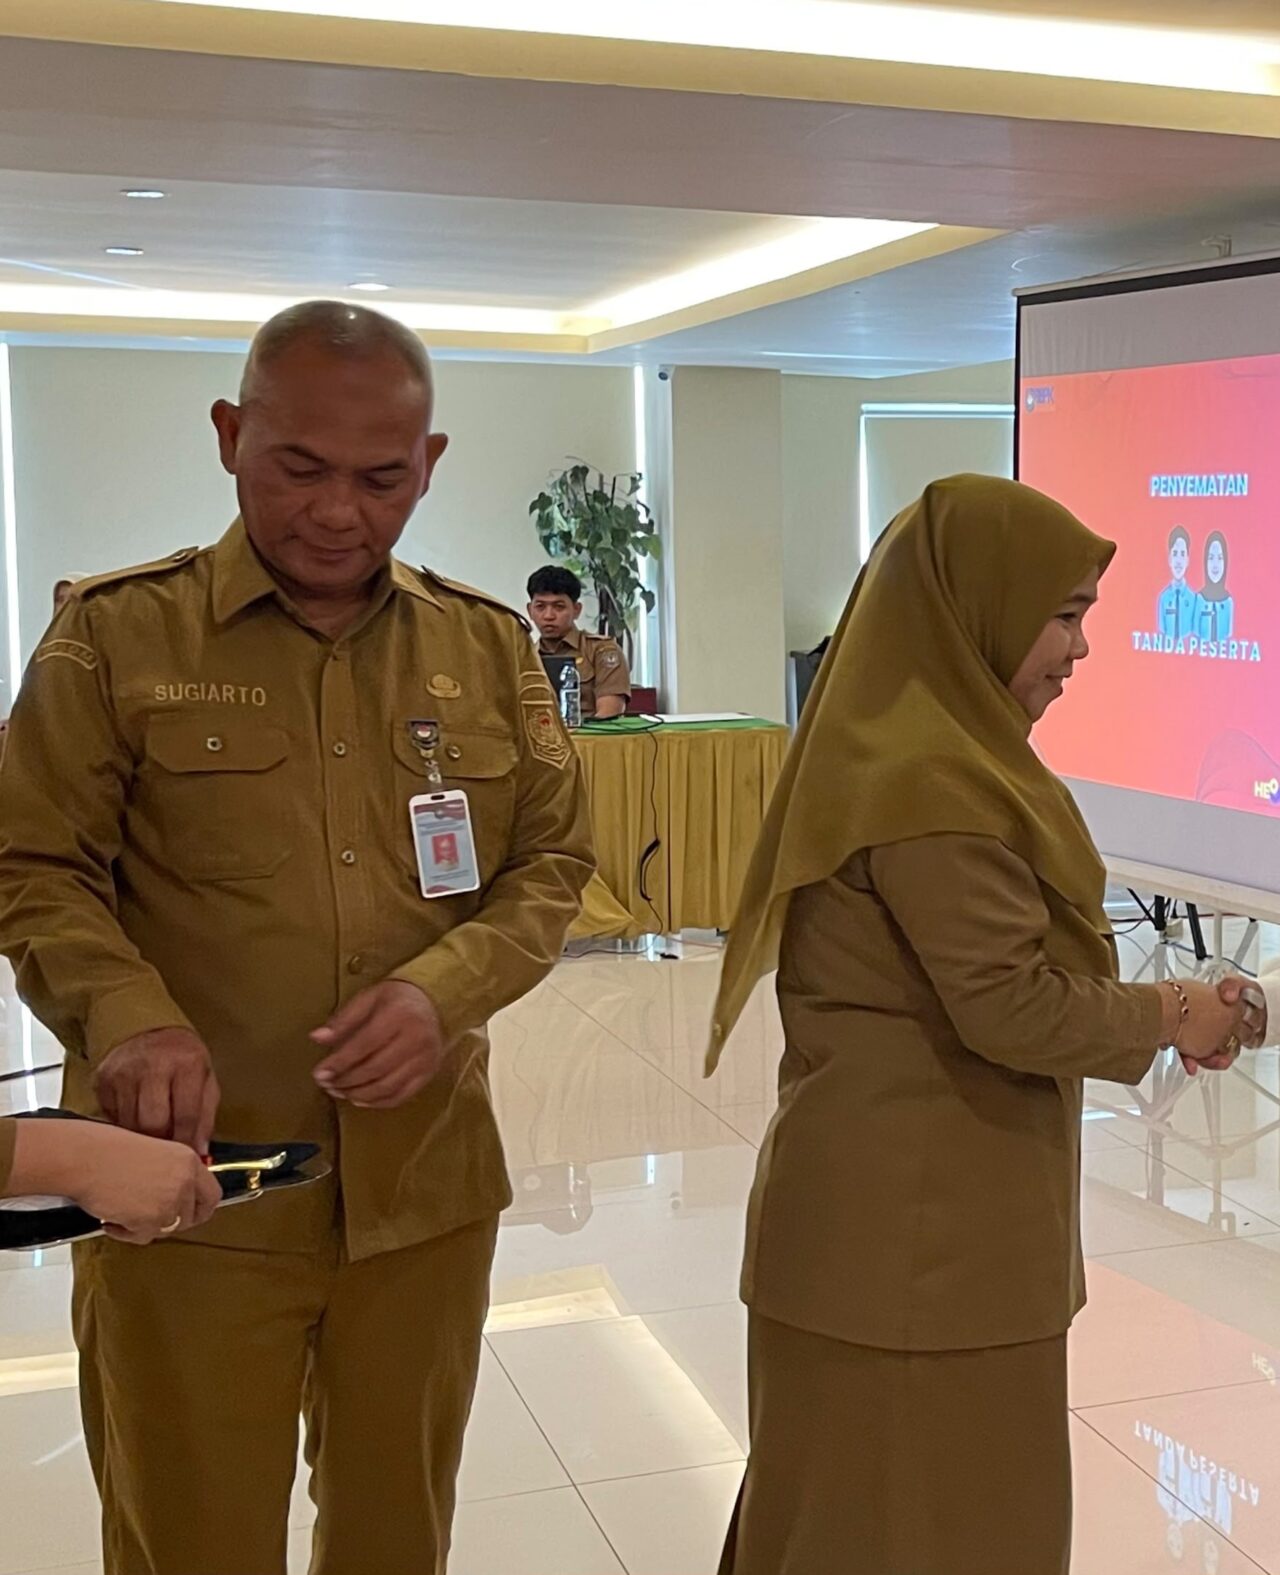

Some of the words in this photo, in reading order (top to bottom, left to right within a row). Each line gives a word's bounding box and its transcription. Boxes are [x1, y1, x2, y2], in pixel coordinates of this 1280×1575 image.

[1150, 473, 1249, 497] PENYEMATAN
[1132, 631, 1186, 656] TANDA
[1189, 639, 1262, 662] PESERTA
[154, 682, 267, 706] SUGIARTO
